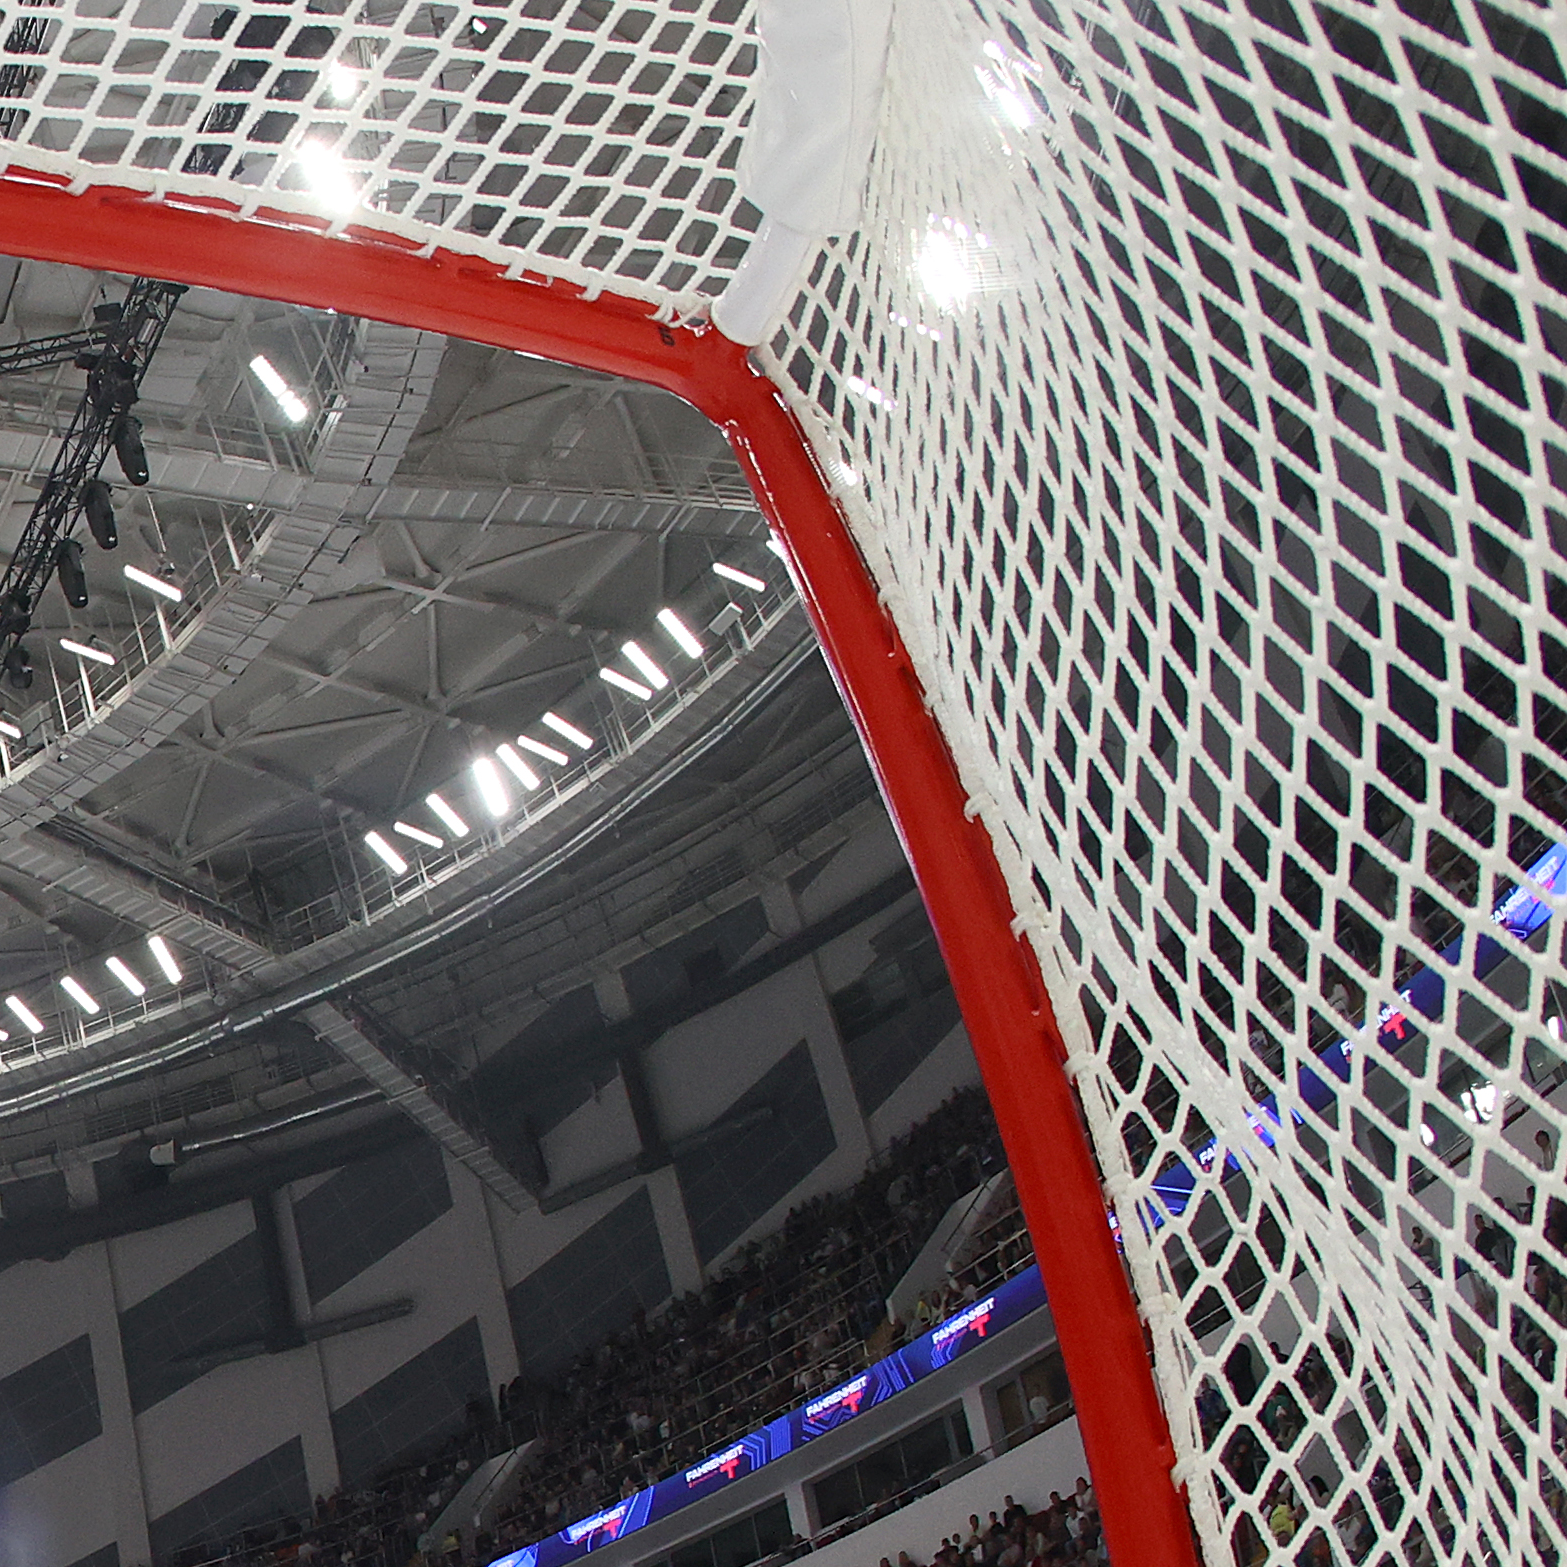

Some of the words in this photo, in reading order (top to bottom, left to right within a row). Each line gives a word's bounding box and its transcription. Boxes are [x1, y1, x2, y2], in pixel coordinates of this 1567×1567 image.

[931, 1297, 996, 1345] FAHRENHEIT
[805, 1376, 868, 1419] FAHRENHEIT
[684, 1446, 745, 1483] FAHRENHEIT
